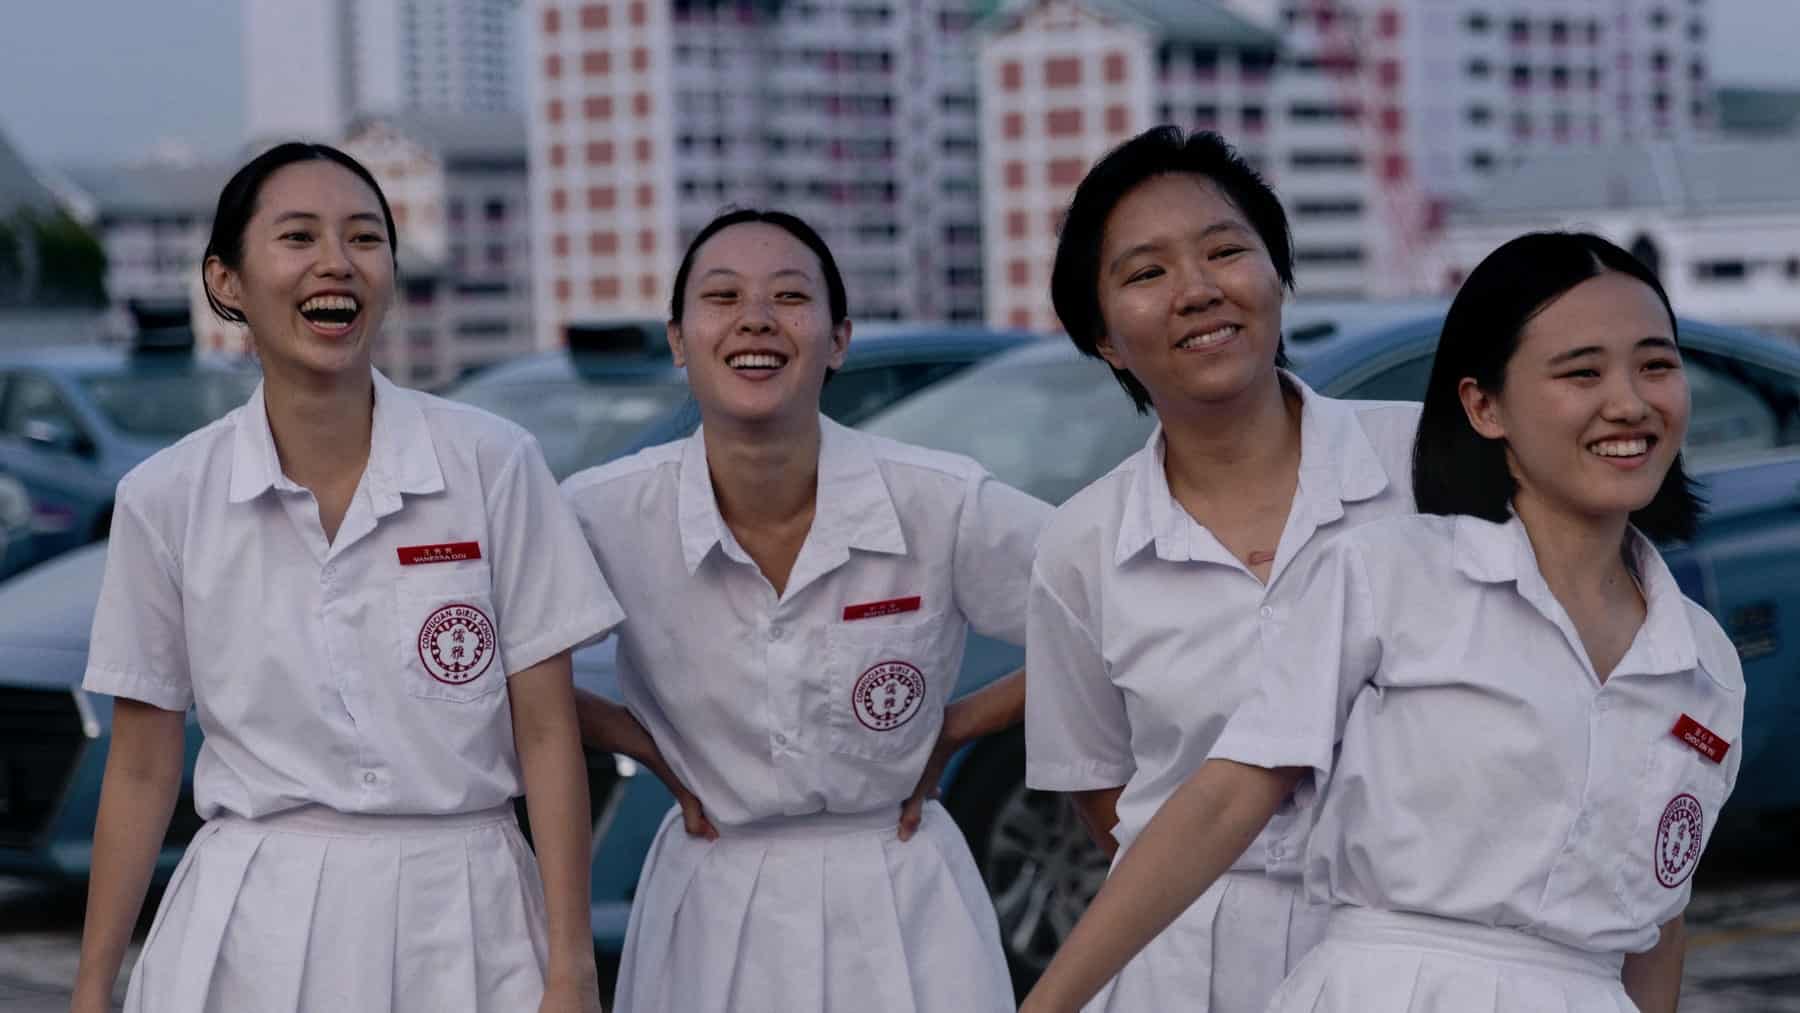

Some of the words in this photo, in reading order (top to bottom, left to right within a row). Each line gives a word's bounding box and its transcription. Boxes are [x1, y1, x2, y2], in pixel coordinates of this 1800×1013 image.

[422, 609, 452, 649] CONFUCIAN
[455, 608, 479, 621] GIRLS
[478, 619, 493, 650] SCHOOL
